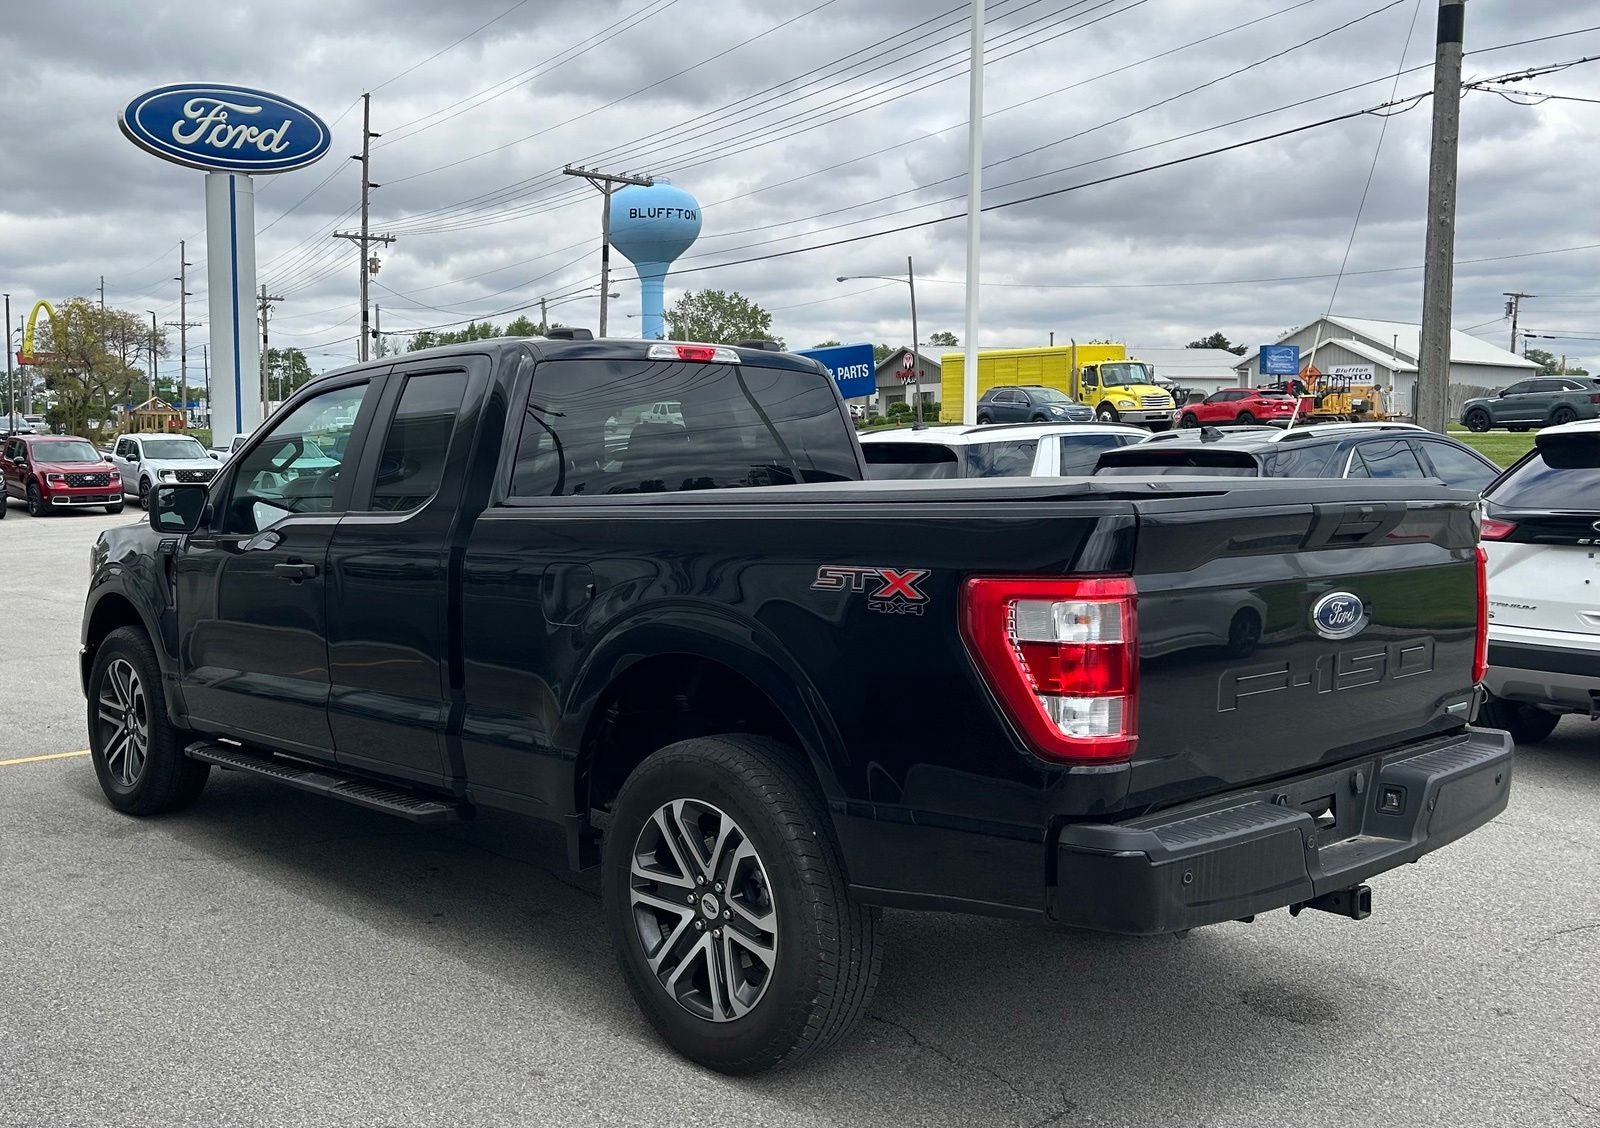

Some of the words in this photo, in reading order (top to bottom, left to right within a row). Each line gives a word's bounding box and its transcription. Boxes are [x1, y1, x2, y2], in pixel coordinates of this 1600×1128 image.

[172, 97, 292, 154] Ford
[629, 208, 697, 221] BLUFFTON
[837, 363, 870, 381] PARTS
[810, 565, 932, 604] STX
[1327, 600, 1355, 626] Ford
[1217, 635, 1436, 713] F-150
